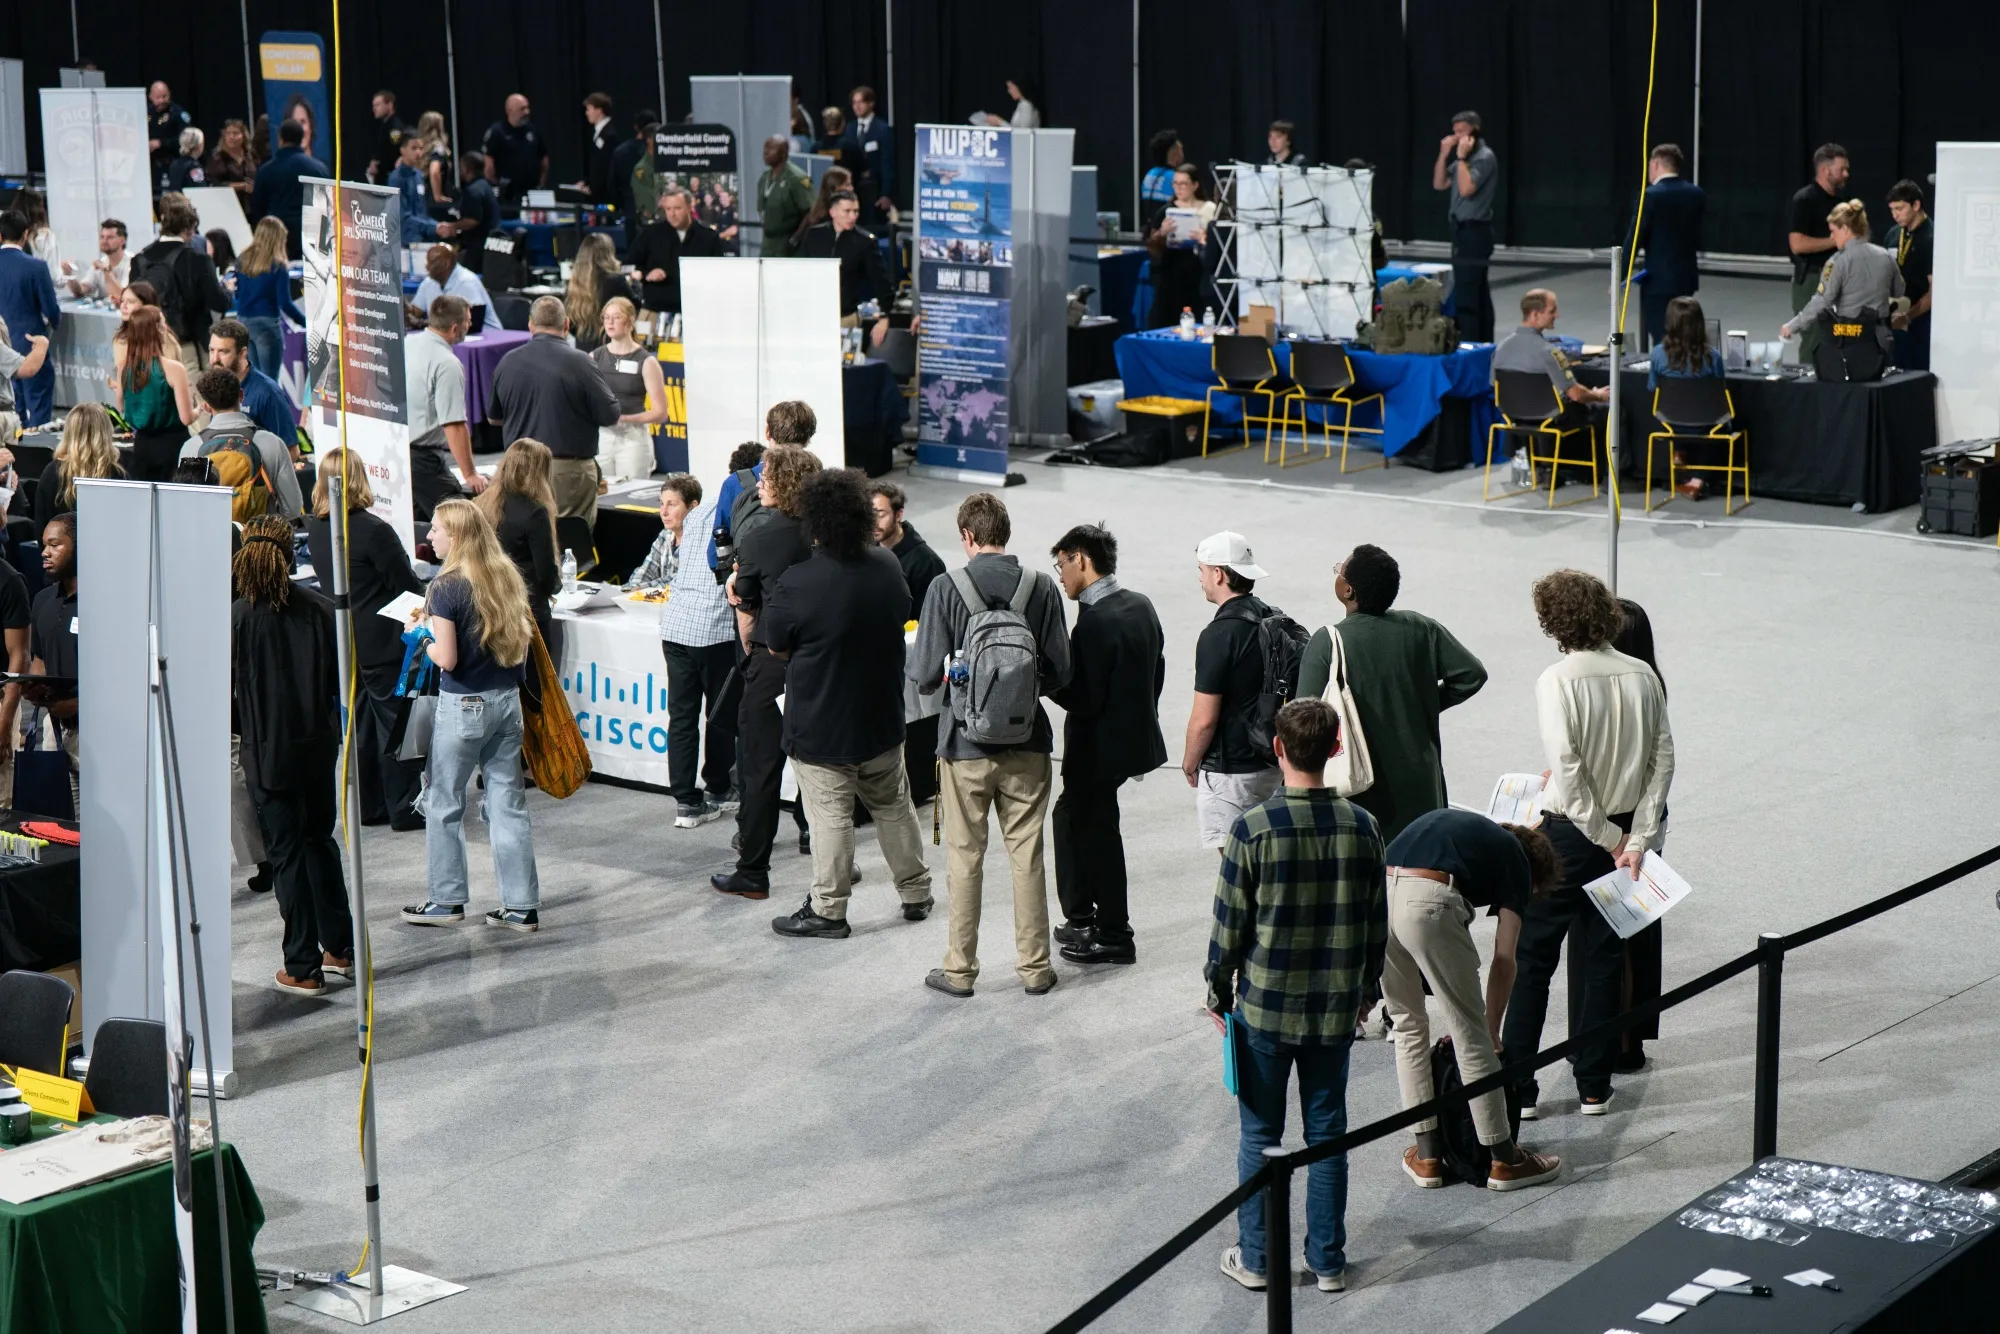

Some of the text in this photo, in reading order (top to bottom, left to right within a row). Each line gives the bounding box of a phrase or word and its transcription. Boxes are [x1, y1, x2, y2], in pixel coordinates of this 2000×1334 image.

[656, 133, 730, 144] Chesterfield County
[658, 145, 728, 156] Police Department
[484, 237, 515, 254] POLICE
[341, 265, 389, 285] OIN OUR TEAM
[346, 288, 399, 304] Implementation Consultants
[346, 305, 386, 319] Software Developers
[347, 323, 398, 340] Software Support Analysts
[1833, 324, 1862, 336] SHERIFF
[349, 341, 382, 355] Project Managers
[349, 358, 360, 367] Sales
[369, 361, 388, 375] Marketing
[351, 396, 398, 412] Charlotte, North Carolina
[665, 424, 687, 439] THE
[369, 465, 389, 480] WE DO
[374, 494, 392, 505] oftware
[576, 712, 668, 754] CISCO
[24, 1089, 69, 1105] Givens Communities
